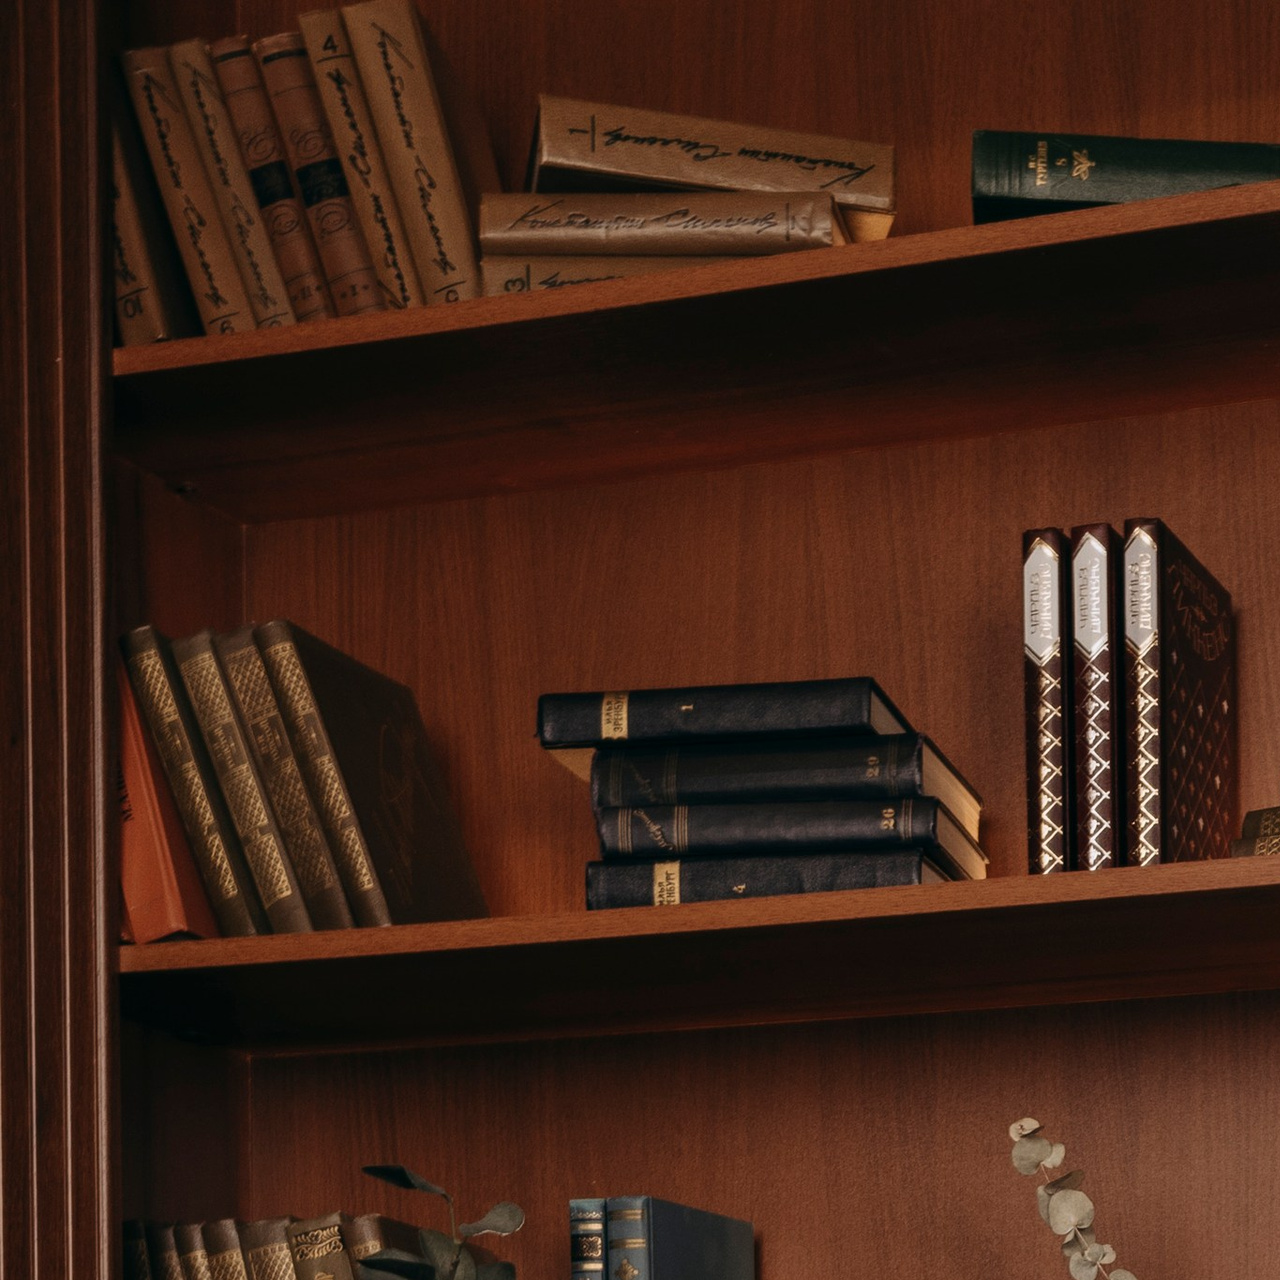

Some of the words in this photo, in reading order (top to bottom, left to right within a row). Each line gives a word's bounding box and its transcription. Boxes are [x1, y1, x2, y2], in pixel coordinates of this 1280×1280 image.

[323, 35, 338, 53] 4
[613, 693, 624, 733] ЭРЕНБУ
[880, 807, 897, 831] 26
